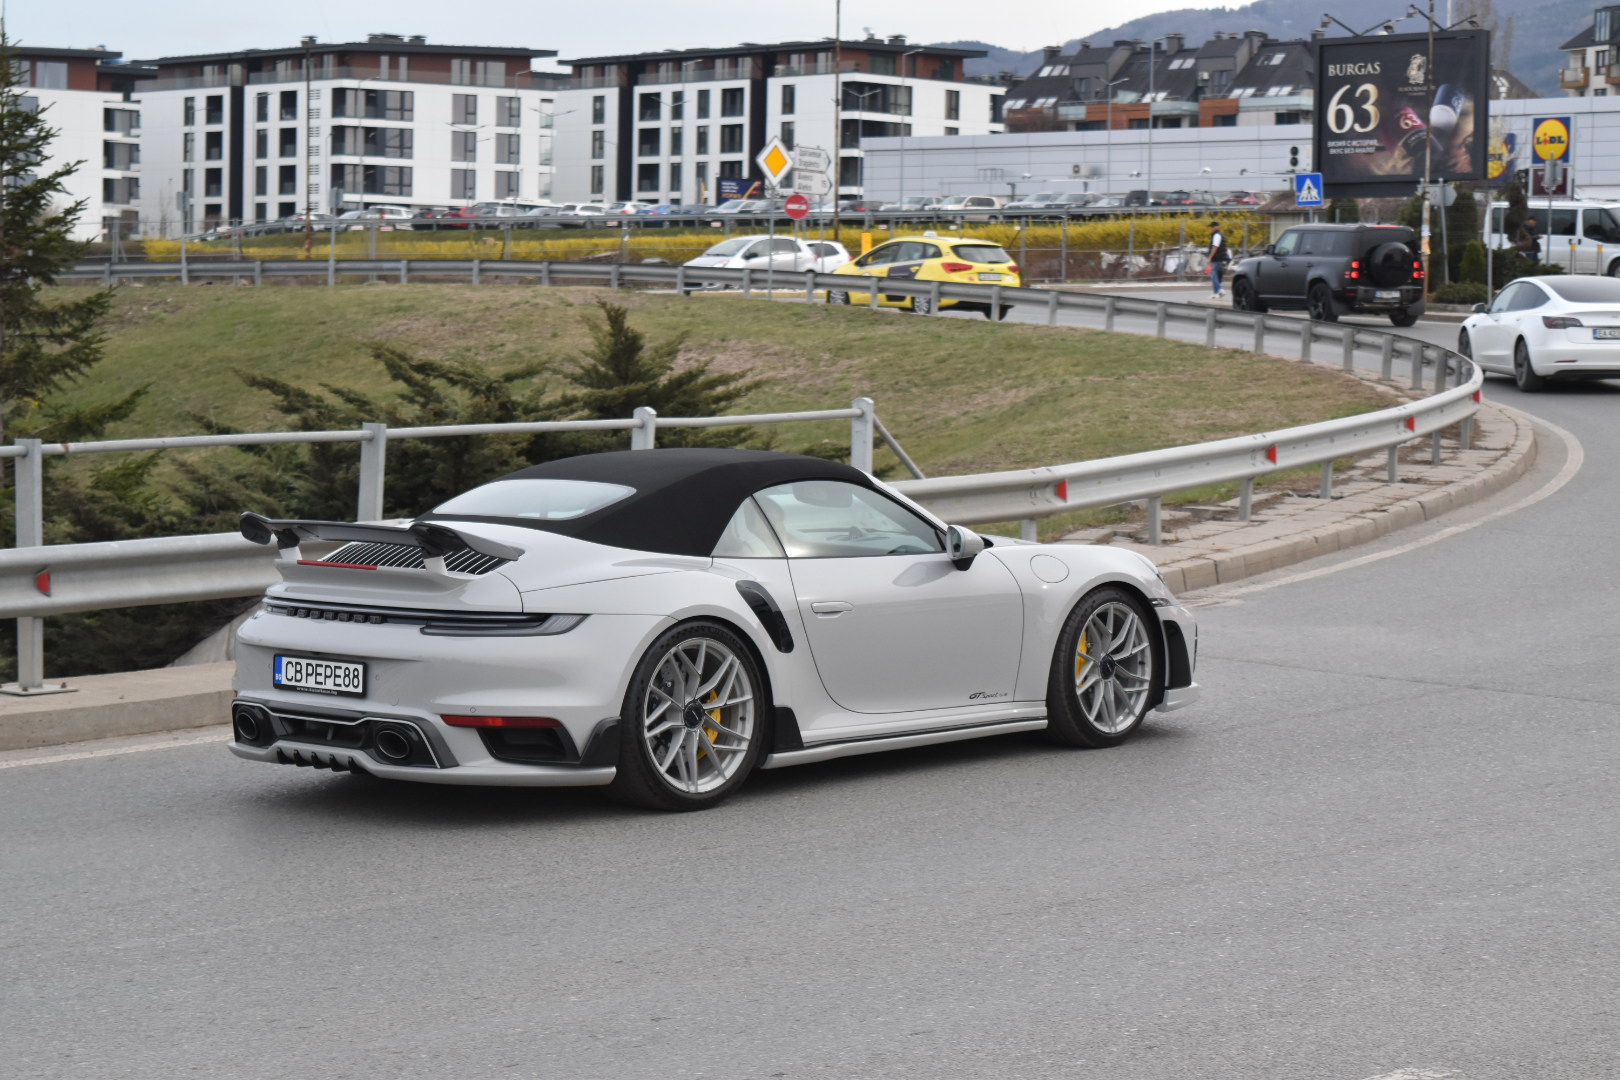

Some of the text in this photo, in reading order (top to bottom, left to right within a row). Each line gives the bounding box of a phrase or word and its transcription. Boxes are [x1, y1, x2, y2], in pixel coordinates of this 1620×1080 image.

[1328, 62, 1381, 77] BURGAS
[1327, 83, 1380, 134] 63
[1400, 113, 1422, 129] 63
[1536, 132, 1565, 145] LIDL
